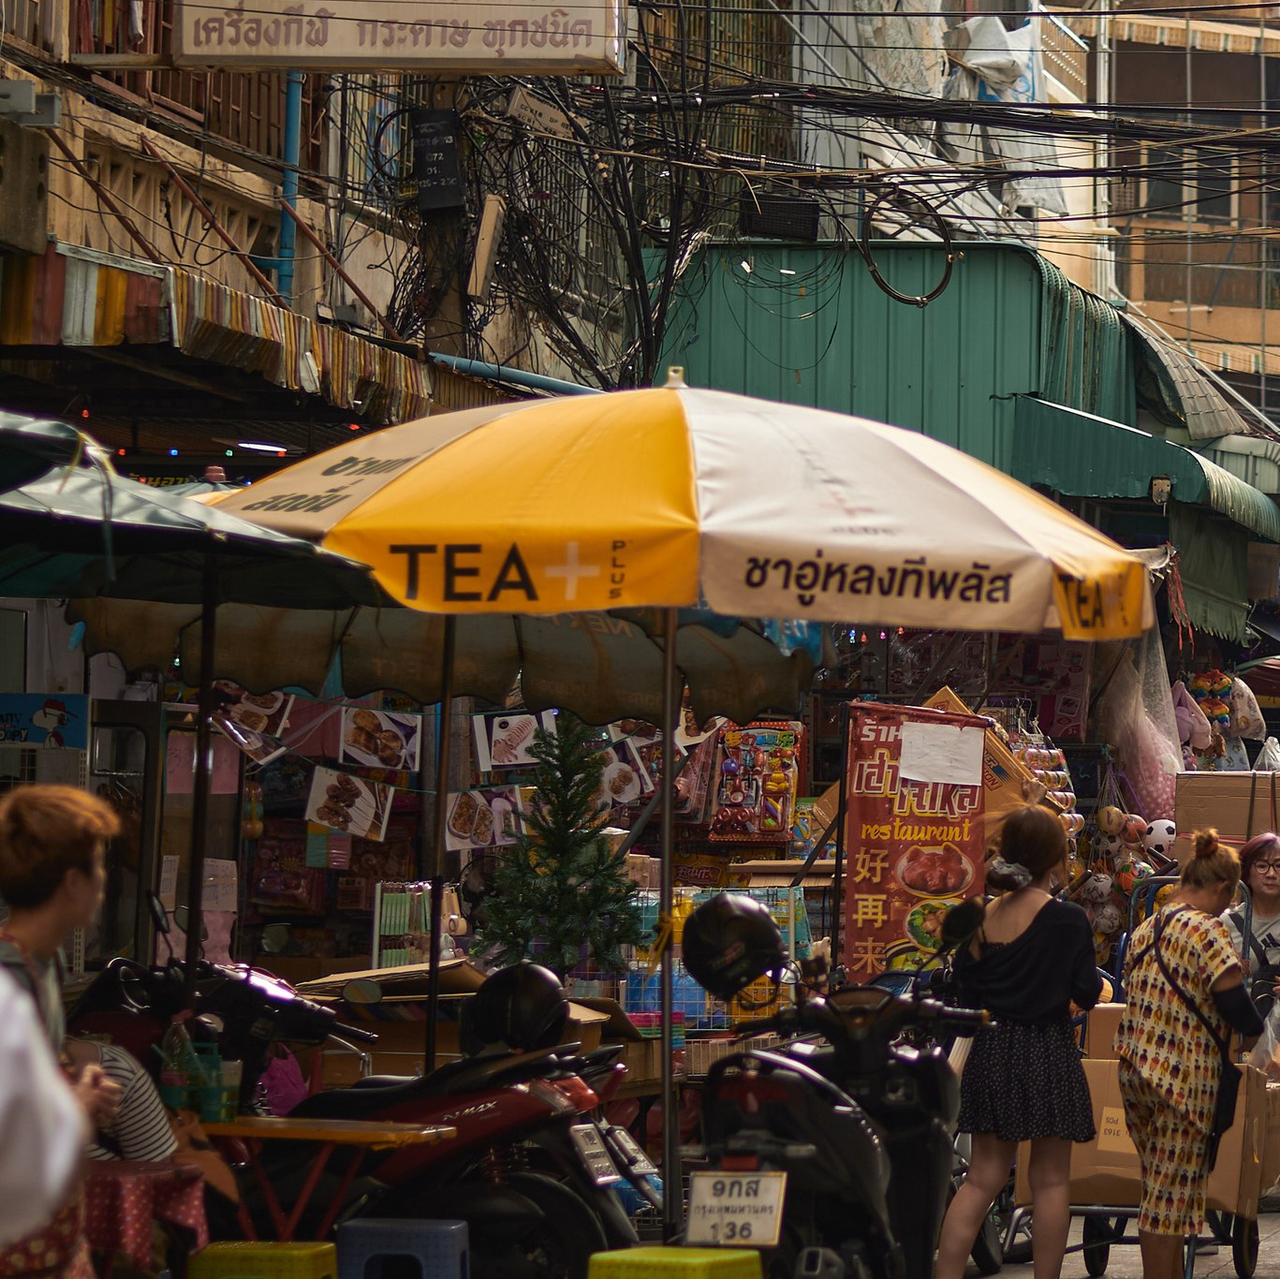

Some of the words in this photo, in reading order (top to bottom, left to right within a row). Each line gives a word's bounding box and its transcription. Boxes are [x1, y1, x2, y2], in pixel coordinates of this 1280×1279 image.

[357, 17, 472, 49] กระดาษ
[482, 8, 594, 57] ทุกชนิด
[744, 549, 1013, 607] ชาอู่หลงทีพลัส
[861, 819, 972, 843] restaurant
